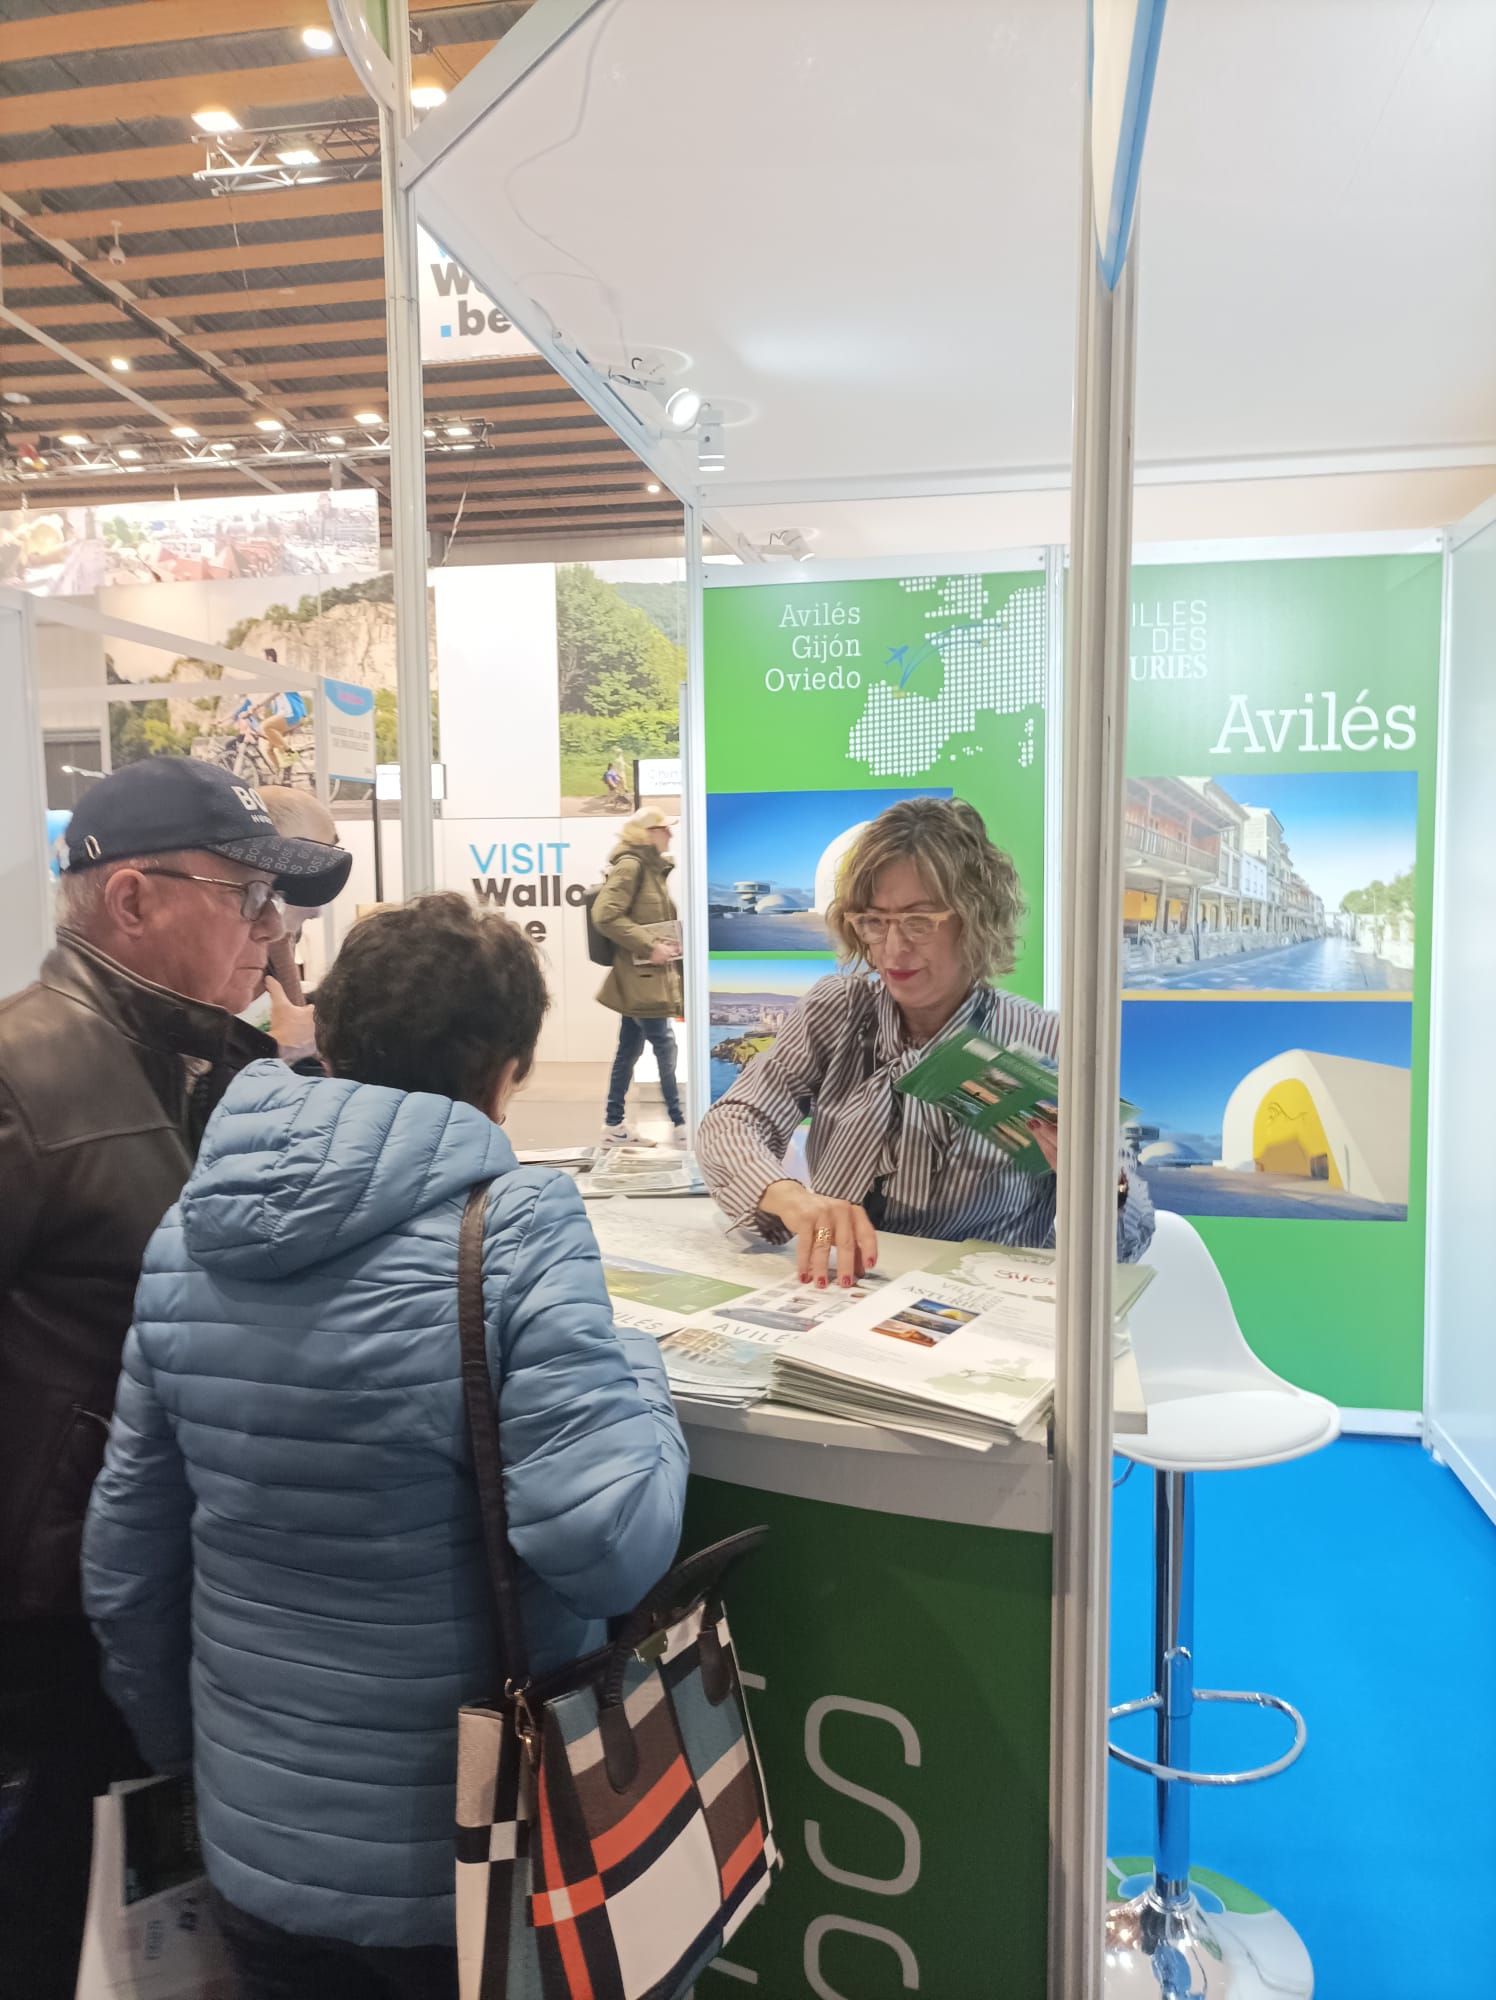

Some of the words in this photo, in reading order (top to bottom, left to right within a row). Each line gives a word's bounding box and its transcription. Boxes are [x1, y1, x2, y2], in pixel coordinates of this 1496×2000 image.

[778, 601, 860, 627] Avilés
[1131, 600, 1207, 627] ILLES
[792, 633, 862, 663] Gijón
[1153, 627, 1207, 653] DES
[765, 666, 861, 692] Oviedo
[1129, 654, 1208, 680] URIES
[1209, 689, 1416, 753] Avilés
[230, 785, 269, 813] BO
[469, 843, 571, 874] VISIT
[472, 875, 587, 907] Wallo
[714, 1322, 800, 1344] AVILE
